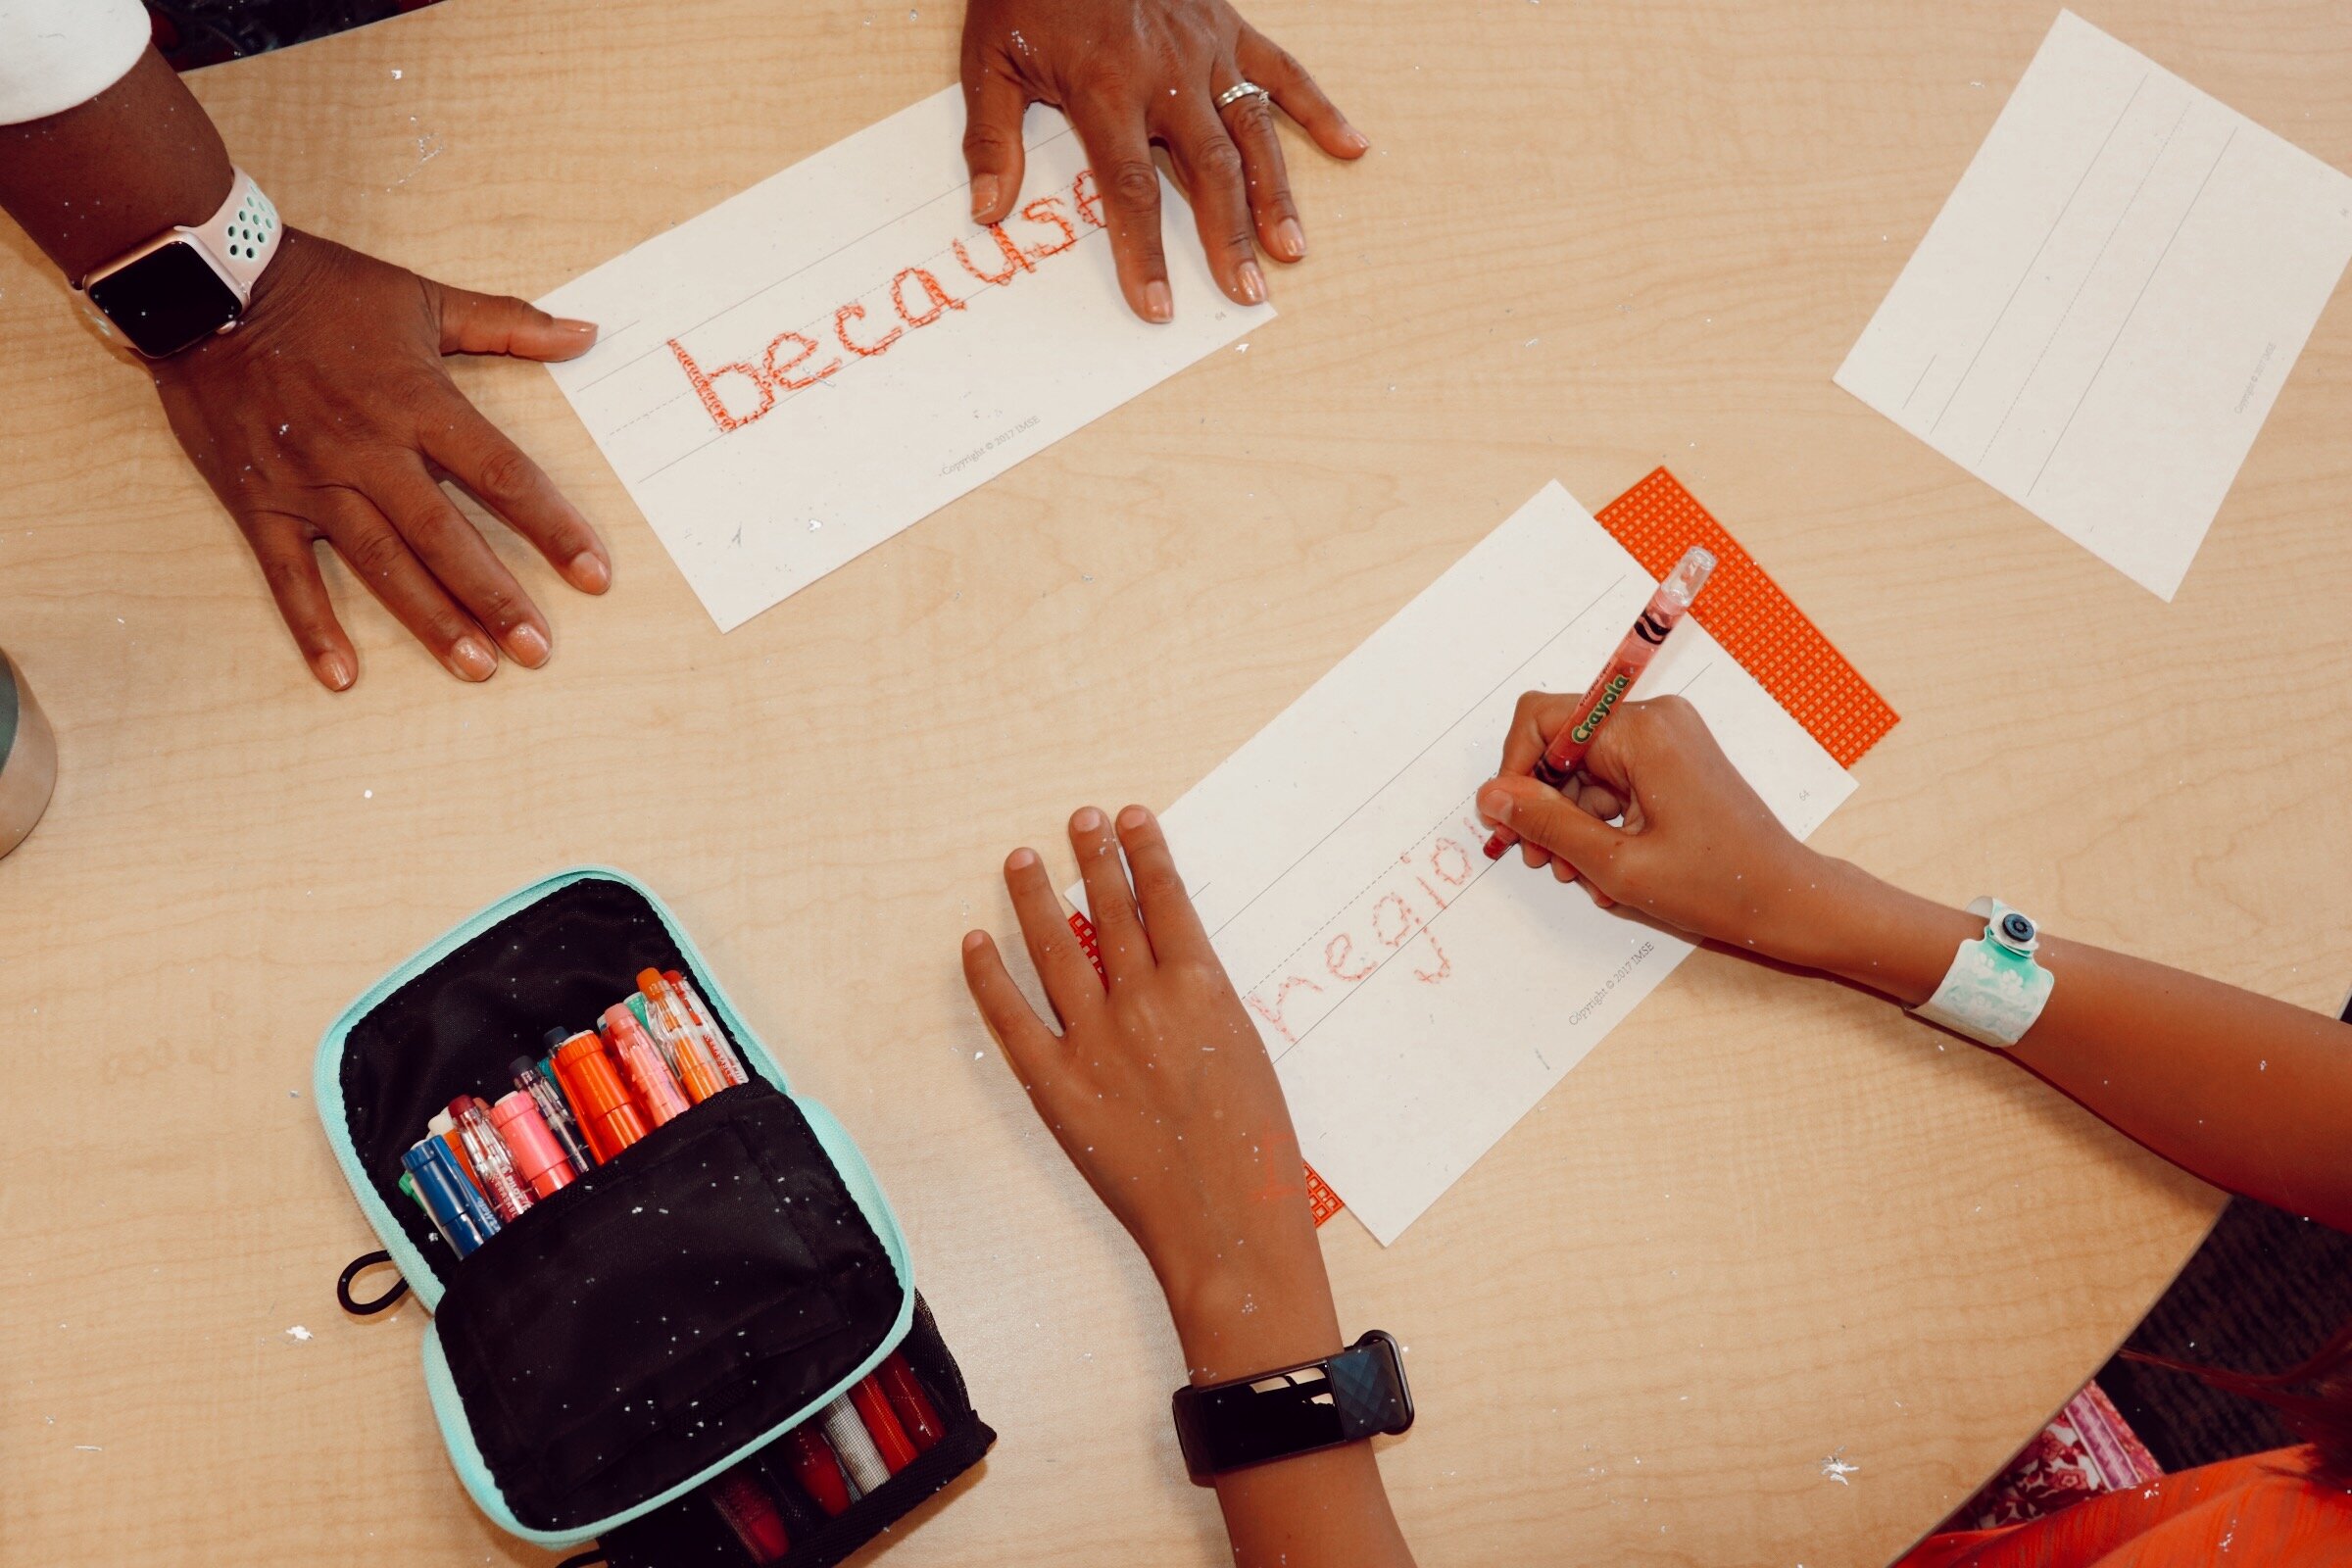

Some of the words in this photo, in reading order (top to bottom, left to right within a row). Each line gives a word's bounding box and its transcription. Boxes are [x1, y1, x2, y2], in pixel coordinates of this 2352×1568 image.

[666, 167, 1108, 433] because
[941, 448, 985, 475] Copyright
[995, 429, 1015, 446] 2017
[1016, 416, 1041, 433] IMSE
[1571, 673, 1631, 743] Crayola
[1248, 817, 1489, 1044] regio
[1568, 988, 1608, 1026] Copyright
[1613, 960, 1633, 983] 2017
[1631, 942, 1654, 965] IMSE
[495, 1182, 517, 1218] ERASABL
[505, 1175, 526, 1200] PILOT
